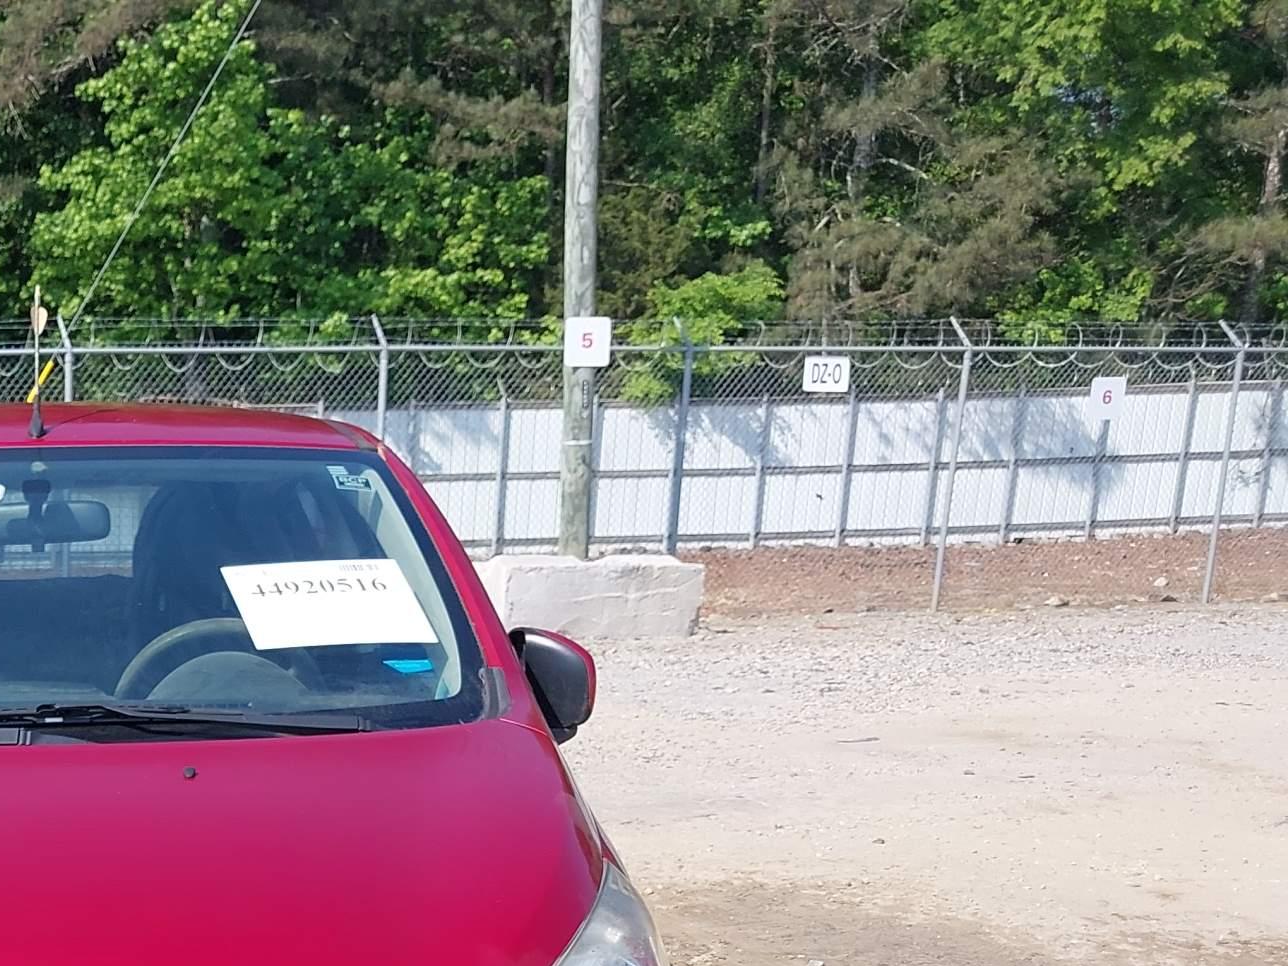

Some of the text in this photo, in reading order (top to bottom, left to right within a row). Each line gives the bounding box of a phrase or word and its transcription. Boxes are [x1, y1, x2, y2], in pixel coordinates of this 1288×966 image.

[581, 332, 593, 349] 5
[1102, 389, 1113, 405] 6
[250, 576, 388, 598] 44920516
